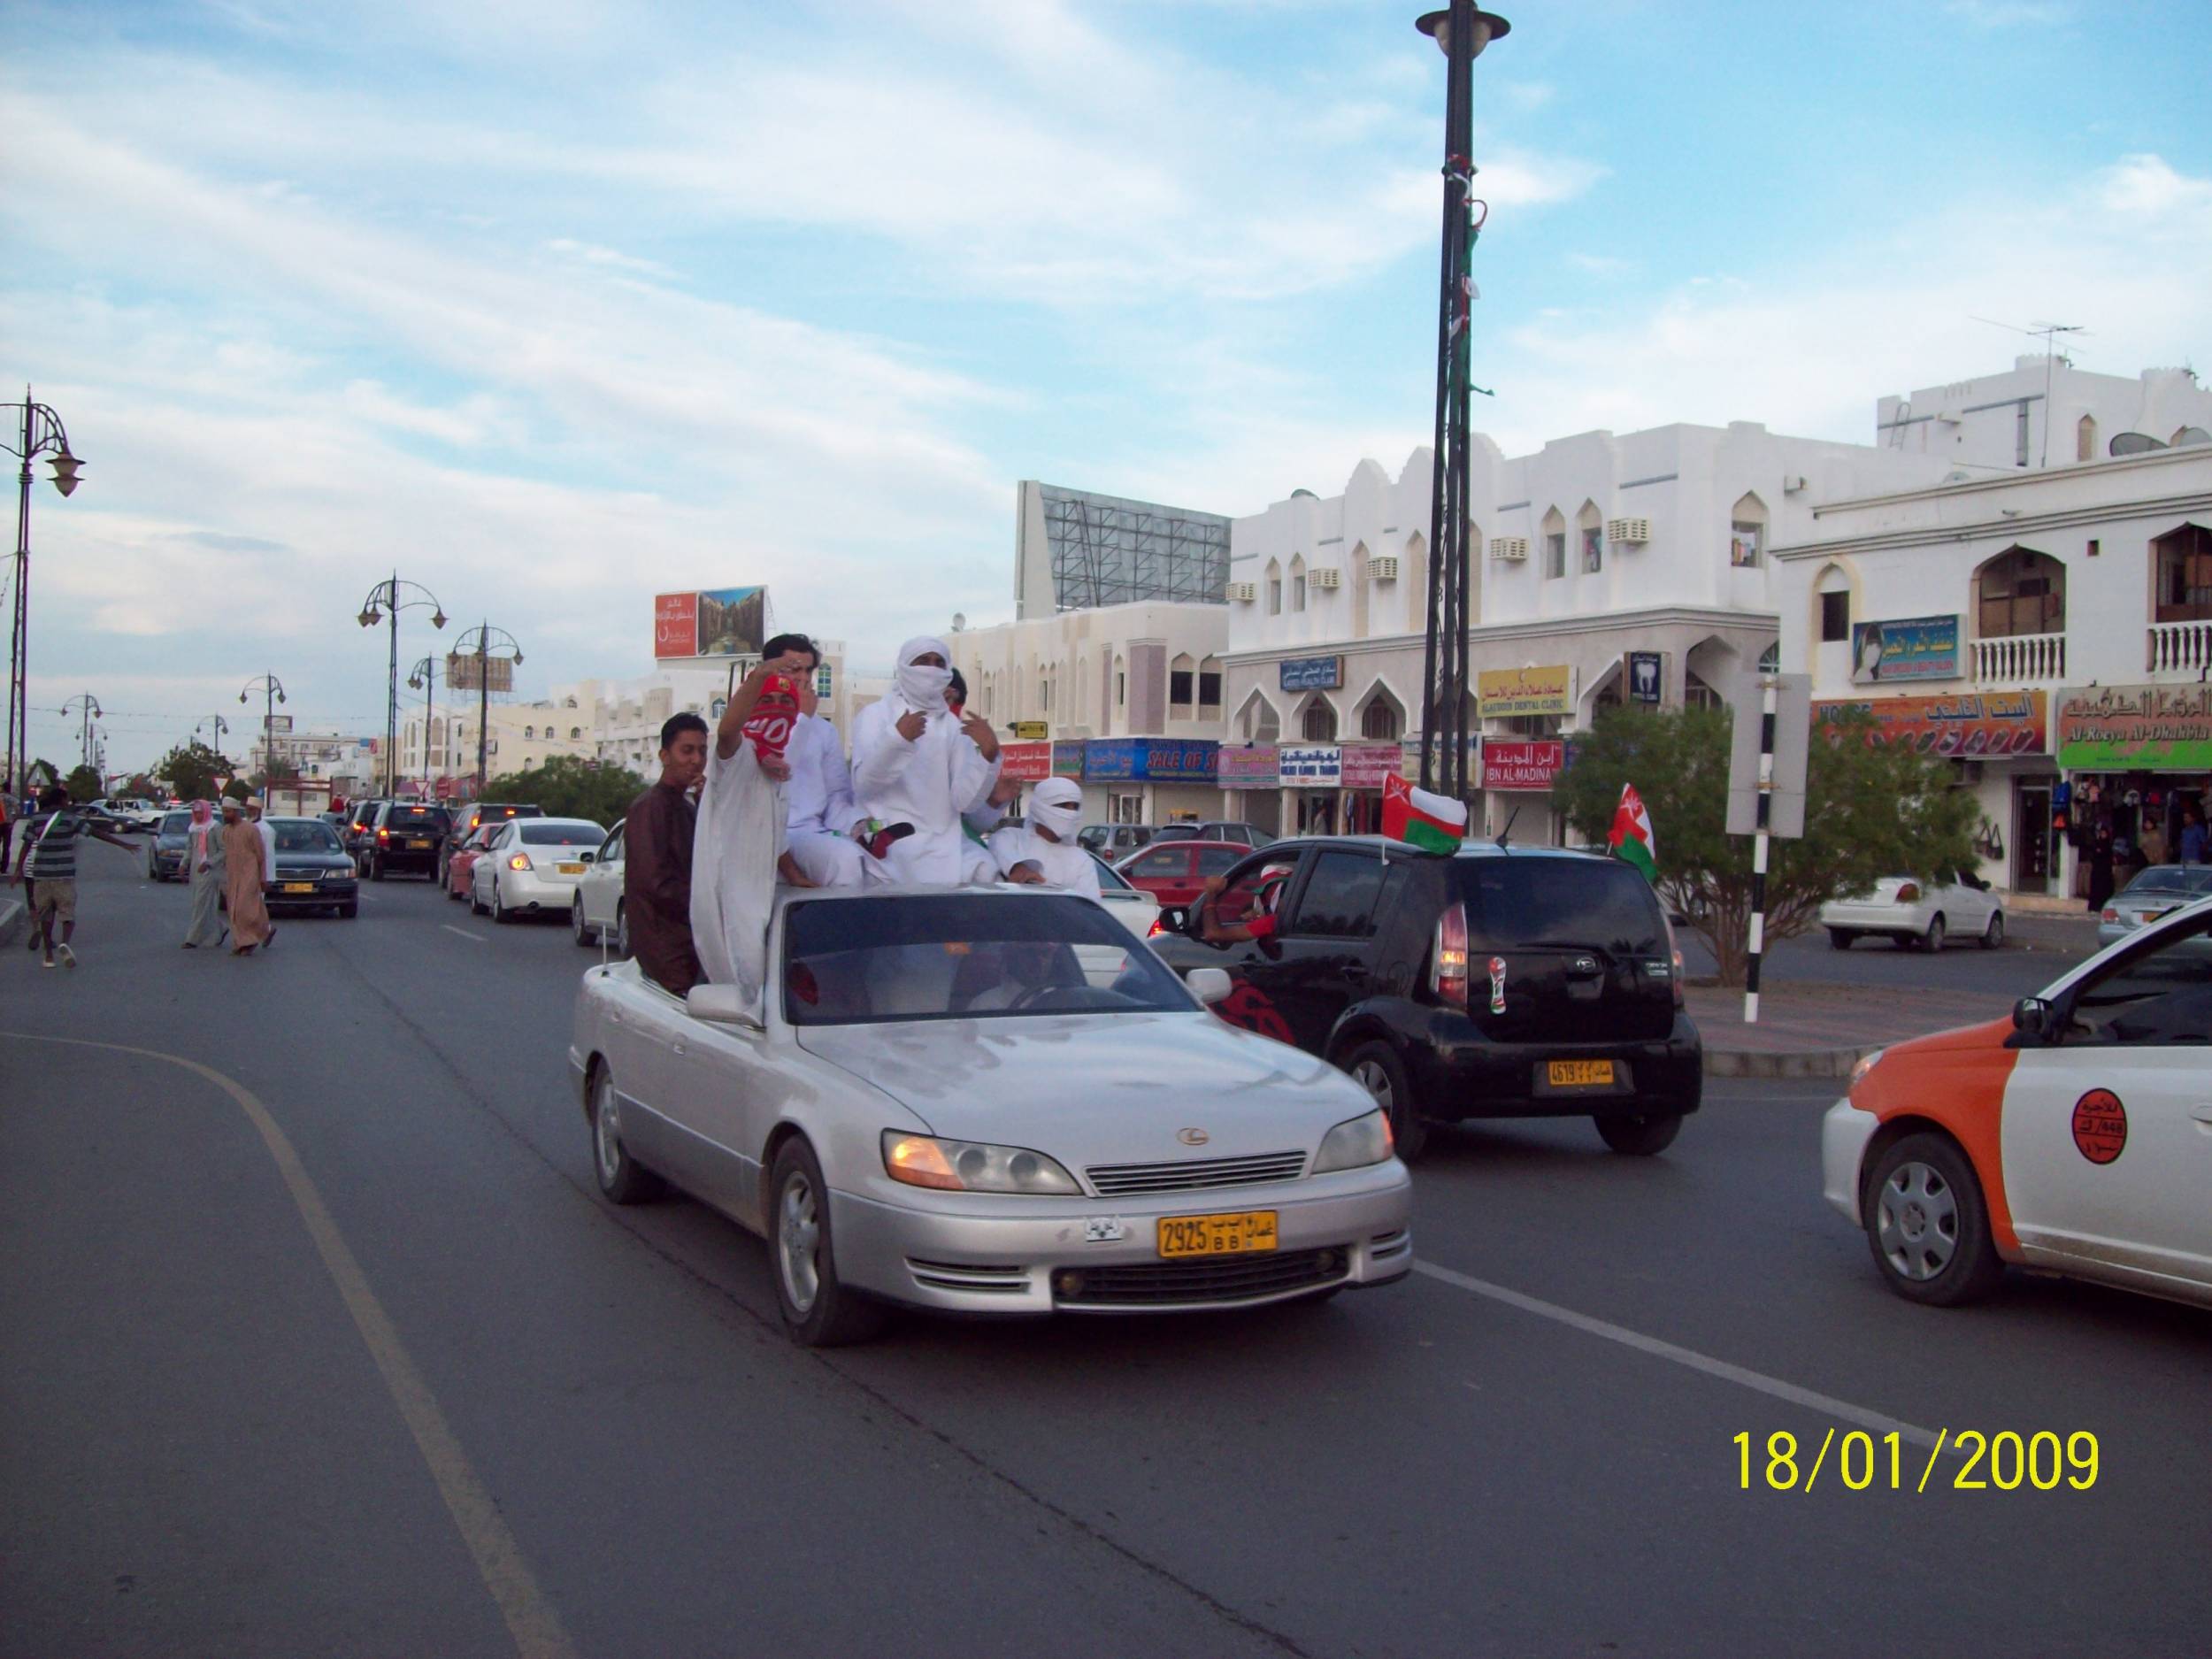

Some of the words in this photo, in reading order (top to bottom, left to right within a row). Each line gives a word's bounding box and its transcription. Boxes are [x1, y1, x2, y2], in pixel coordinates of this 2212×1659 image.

[1148, 750, 1180, 769] SALE
[1185, 751, 1202, 769] OF
[1486, 767, 1502, 780] IBN
[1503, 767, 1551, 781] AL-MADINA
[1163, 1220, 1207, 1253] 2925
